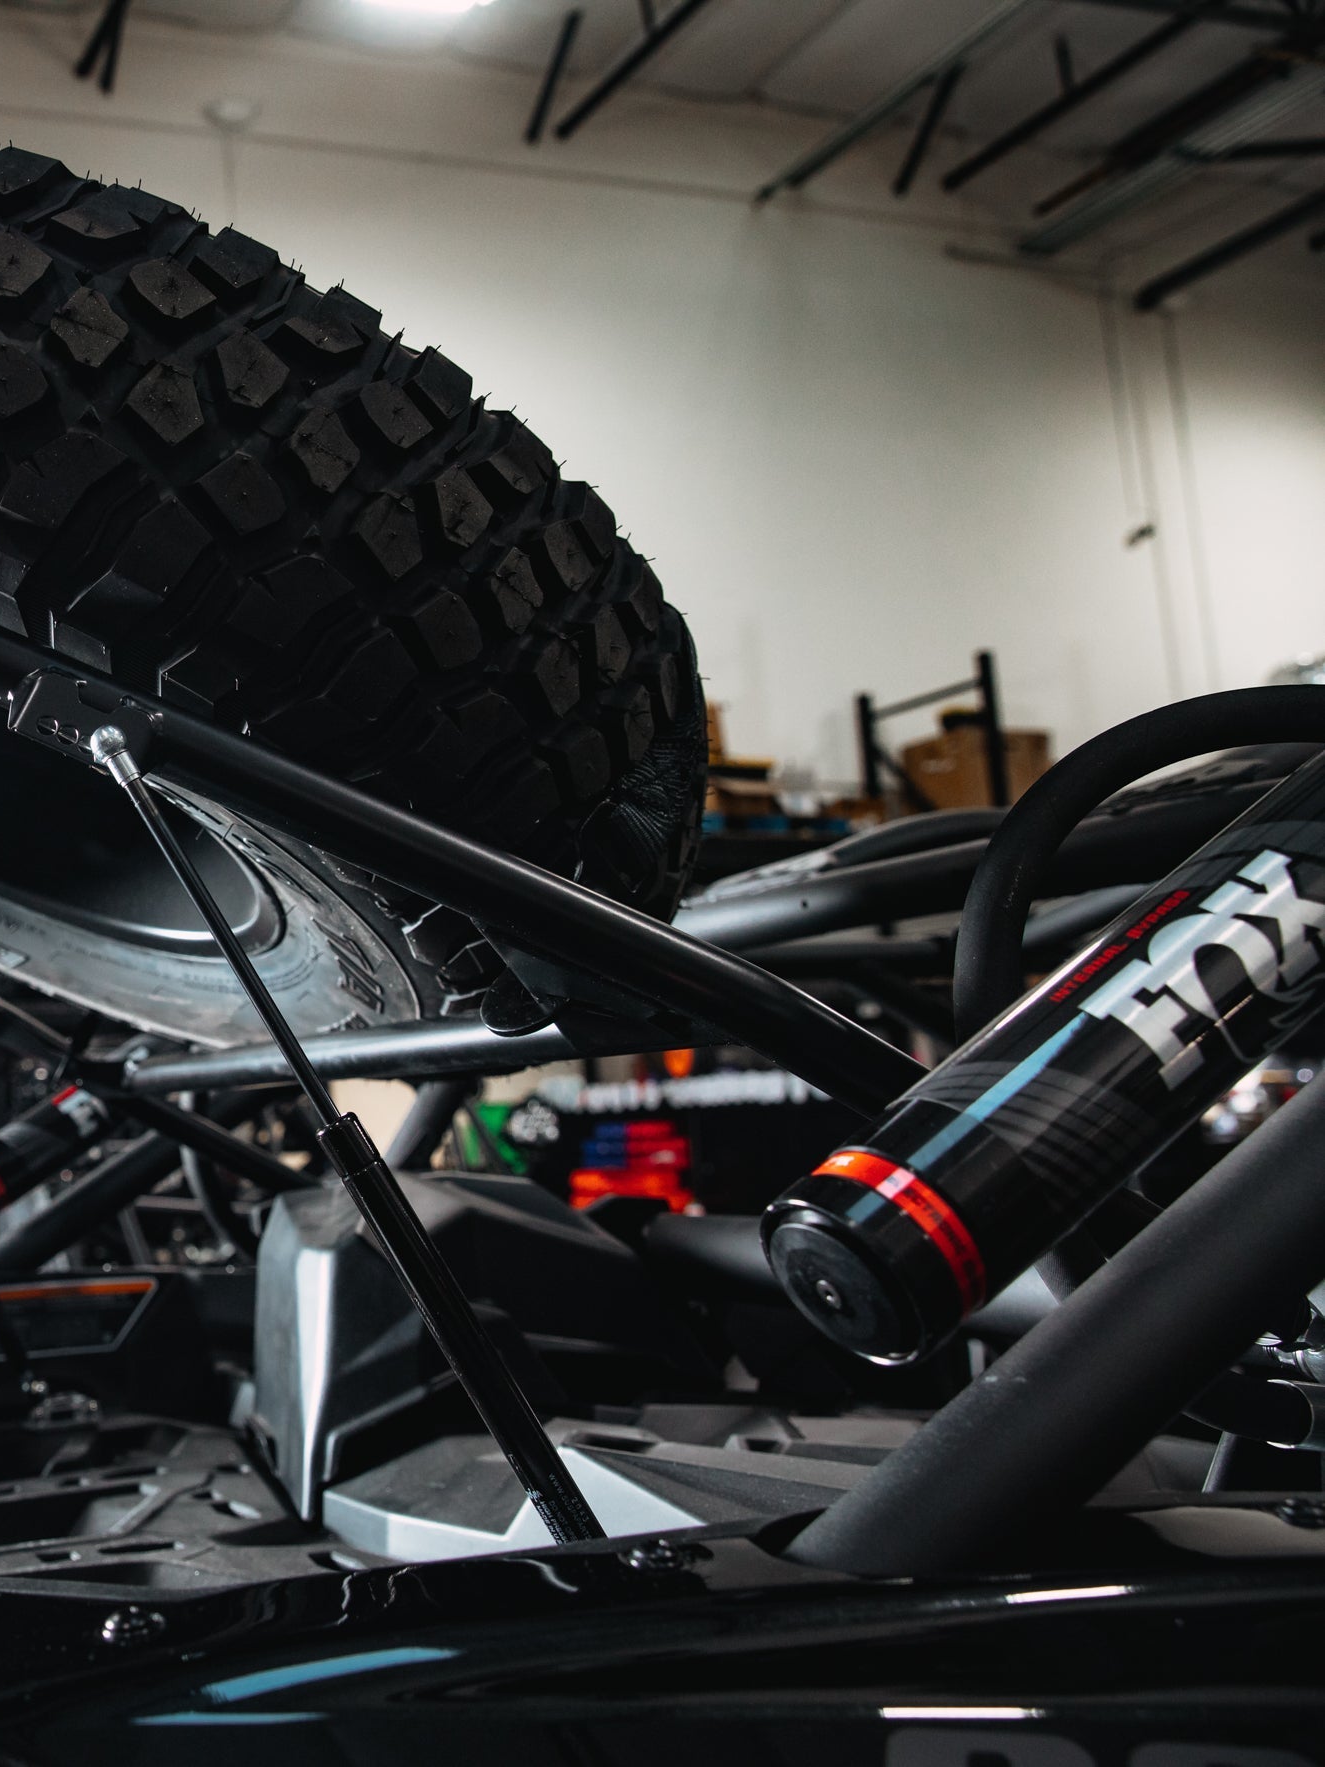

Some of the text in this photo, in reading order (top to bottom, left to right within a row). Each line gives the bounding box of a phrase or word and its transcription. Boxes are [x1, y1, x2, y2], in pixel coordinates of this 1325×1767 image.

[1049, 889, 1191, 1003] INTERNAL BYPASS
[1078, 849, 1325, 1091] FOX
